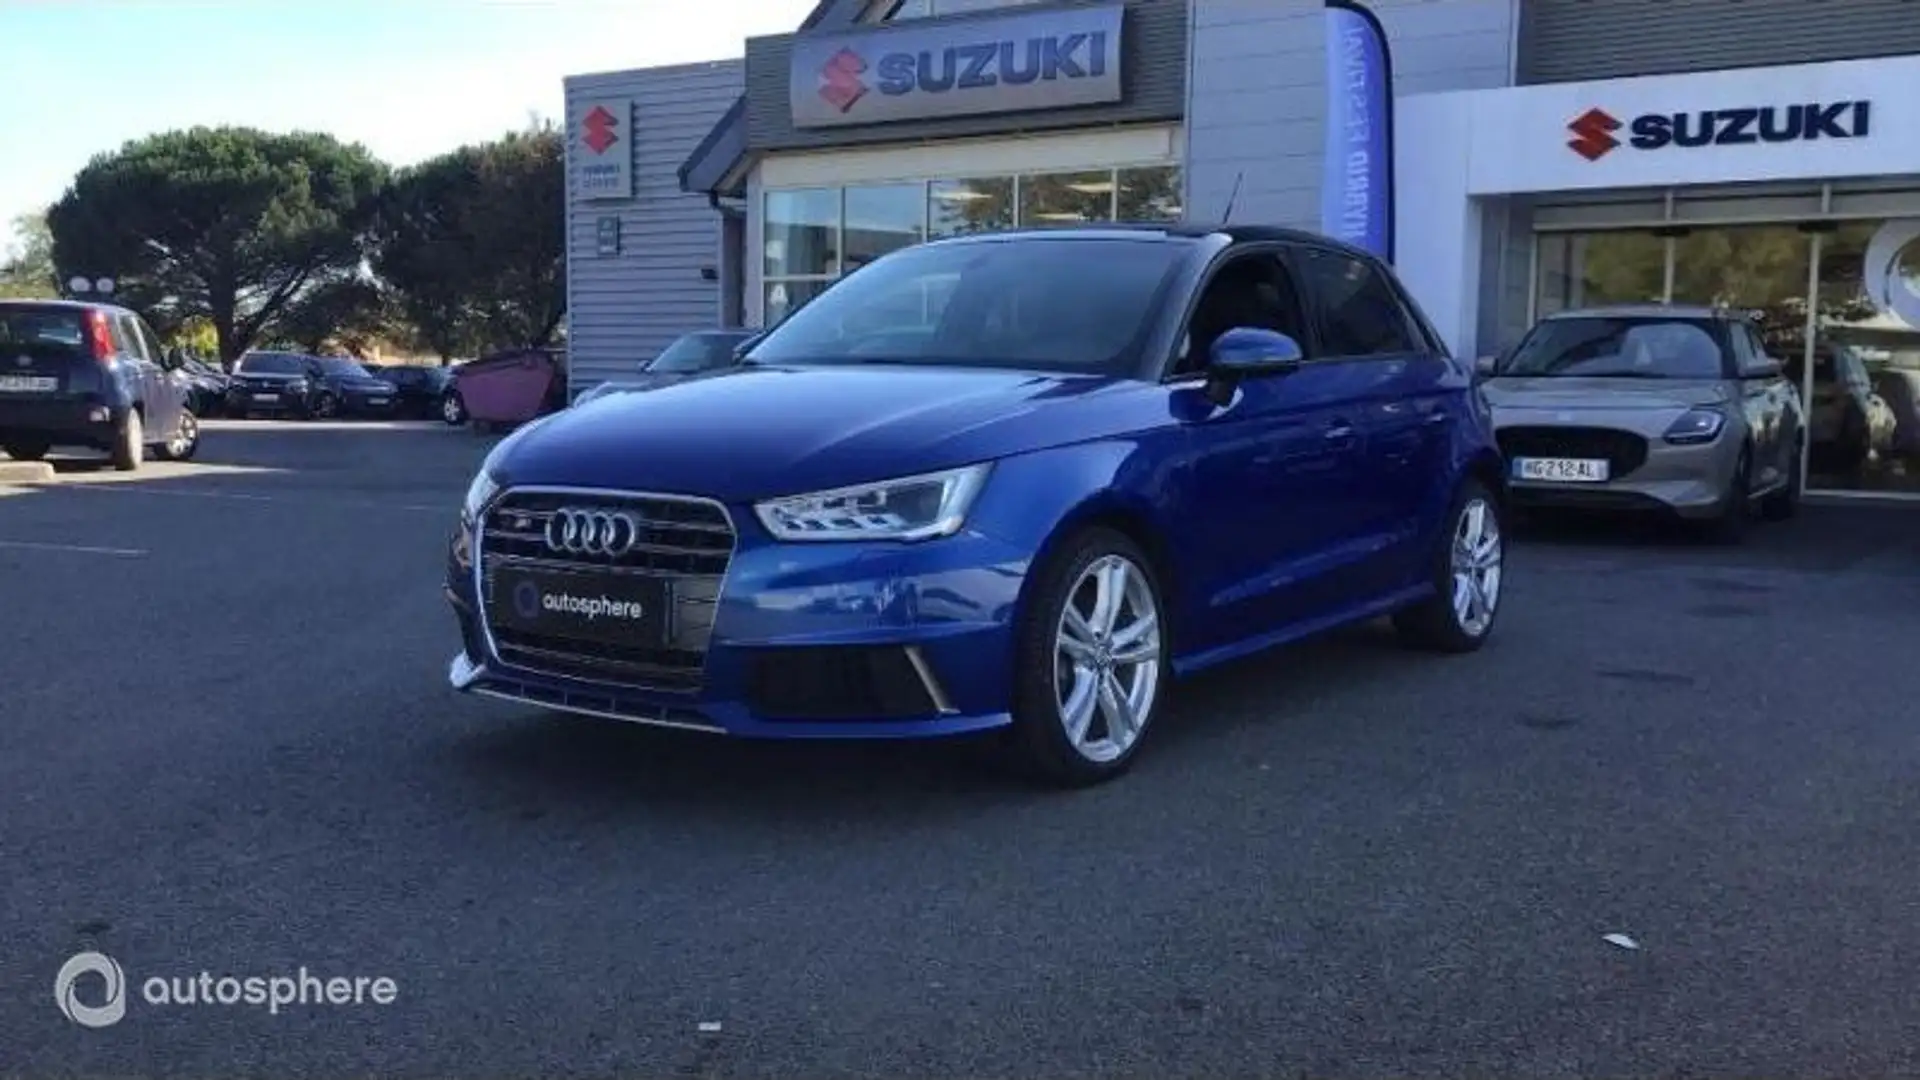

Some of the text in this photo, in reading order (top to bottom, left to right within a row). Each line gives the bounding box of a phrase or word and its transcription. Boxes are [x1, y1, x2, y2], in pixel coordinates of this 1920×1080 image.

[876, 31, 1107, 95] SUZUKI
[1630, 100, 1870, 149] SUZUKI
[542, 591, 642, 619] autosphere
